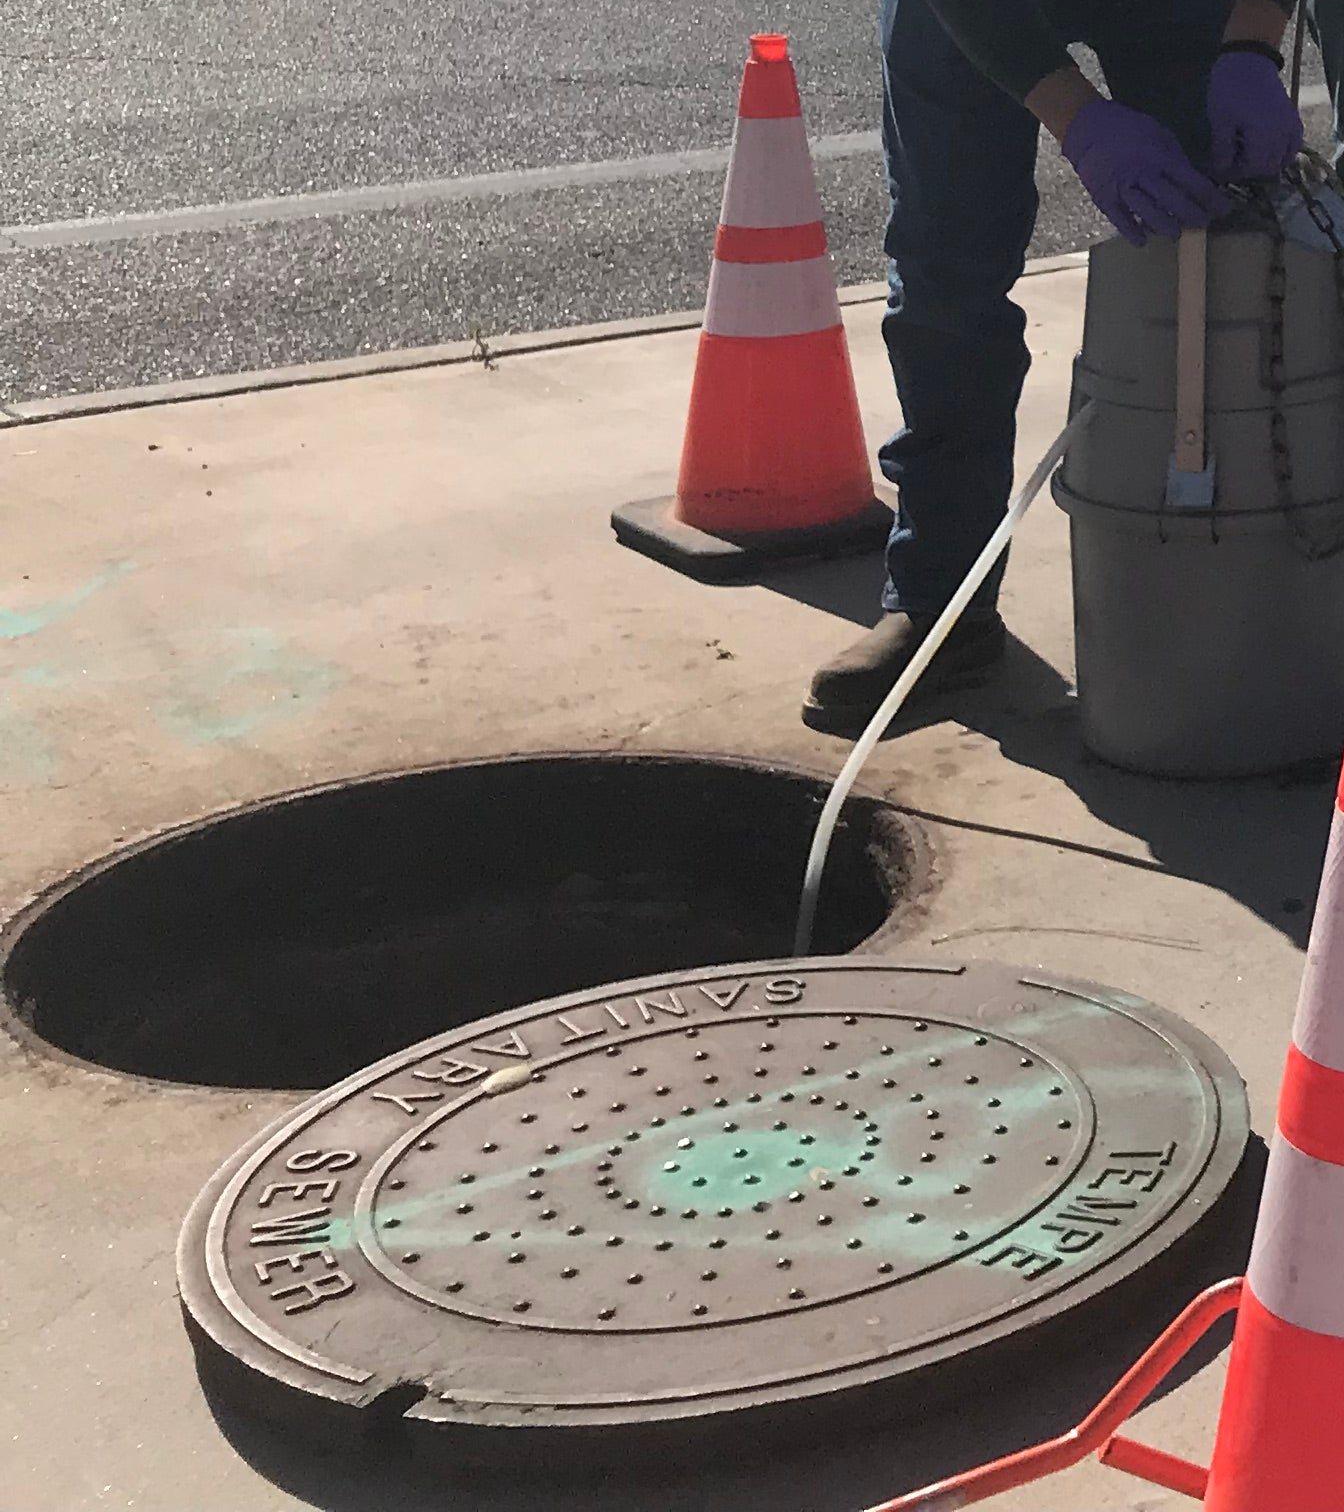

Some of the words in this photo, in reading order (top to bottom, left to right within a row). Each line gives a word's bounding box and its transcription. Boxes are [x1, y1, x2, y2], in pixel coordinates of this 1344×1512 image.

[373, 974, 808, 1117] SANITARY
[246, 1144, 358, 1317] SEWER
[974, 1140, 1178, 1281] TEMPE
